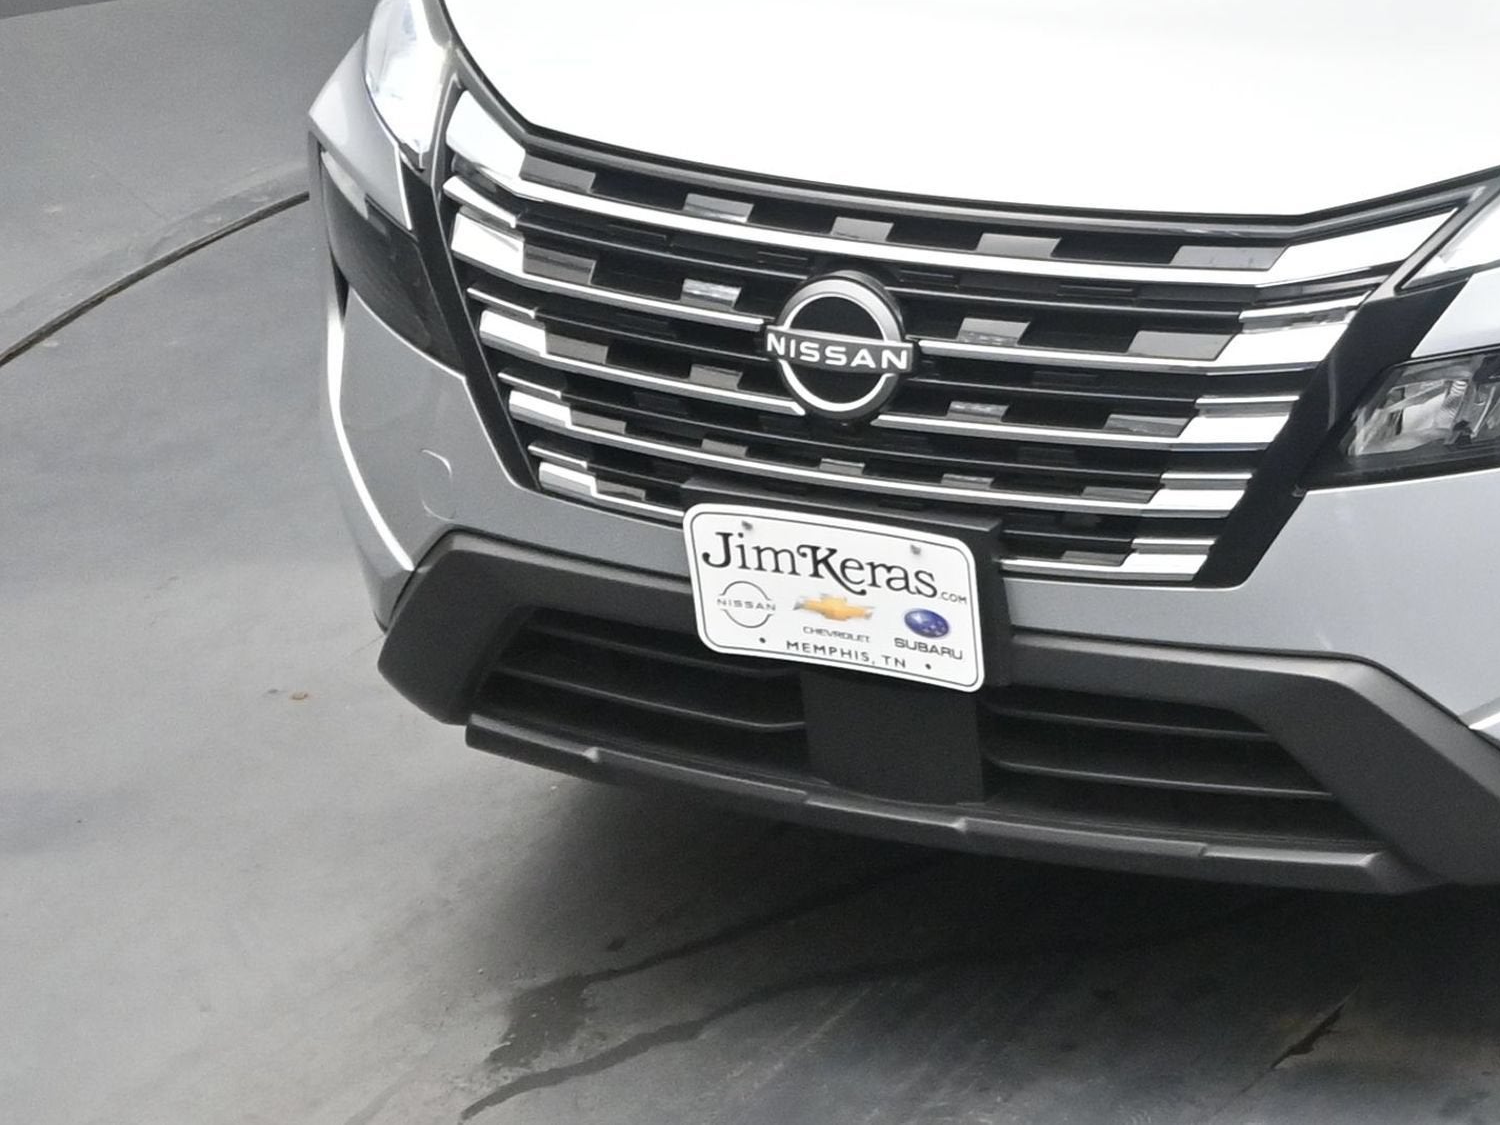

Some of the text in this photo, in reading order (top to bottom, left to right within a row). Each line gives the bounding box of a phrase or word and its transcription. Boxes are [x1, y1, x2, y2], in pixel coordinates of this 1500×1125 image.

[766, 332, 908, 370] NISSAN
[717, 597, 776, 612] NISSAN
[802, 625, 871, 643] CHEVROLET
[785, 639, 906, 669] MEMPHIS, TN
[894, 636, 963, 660] SUBARU
